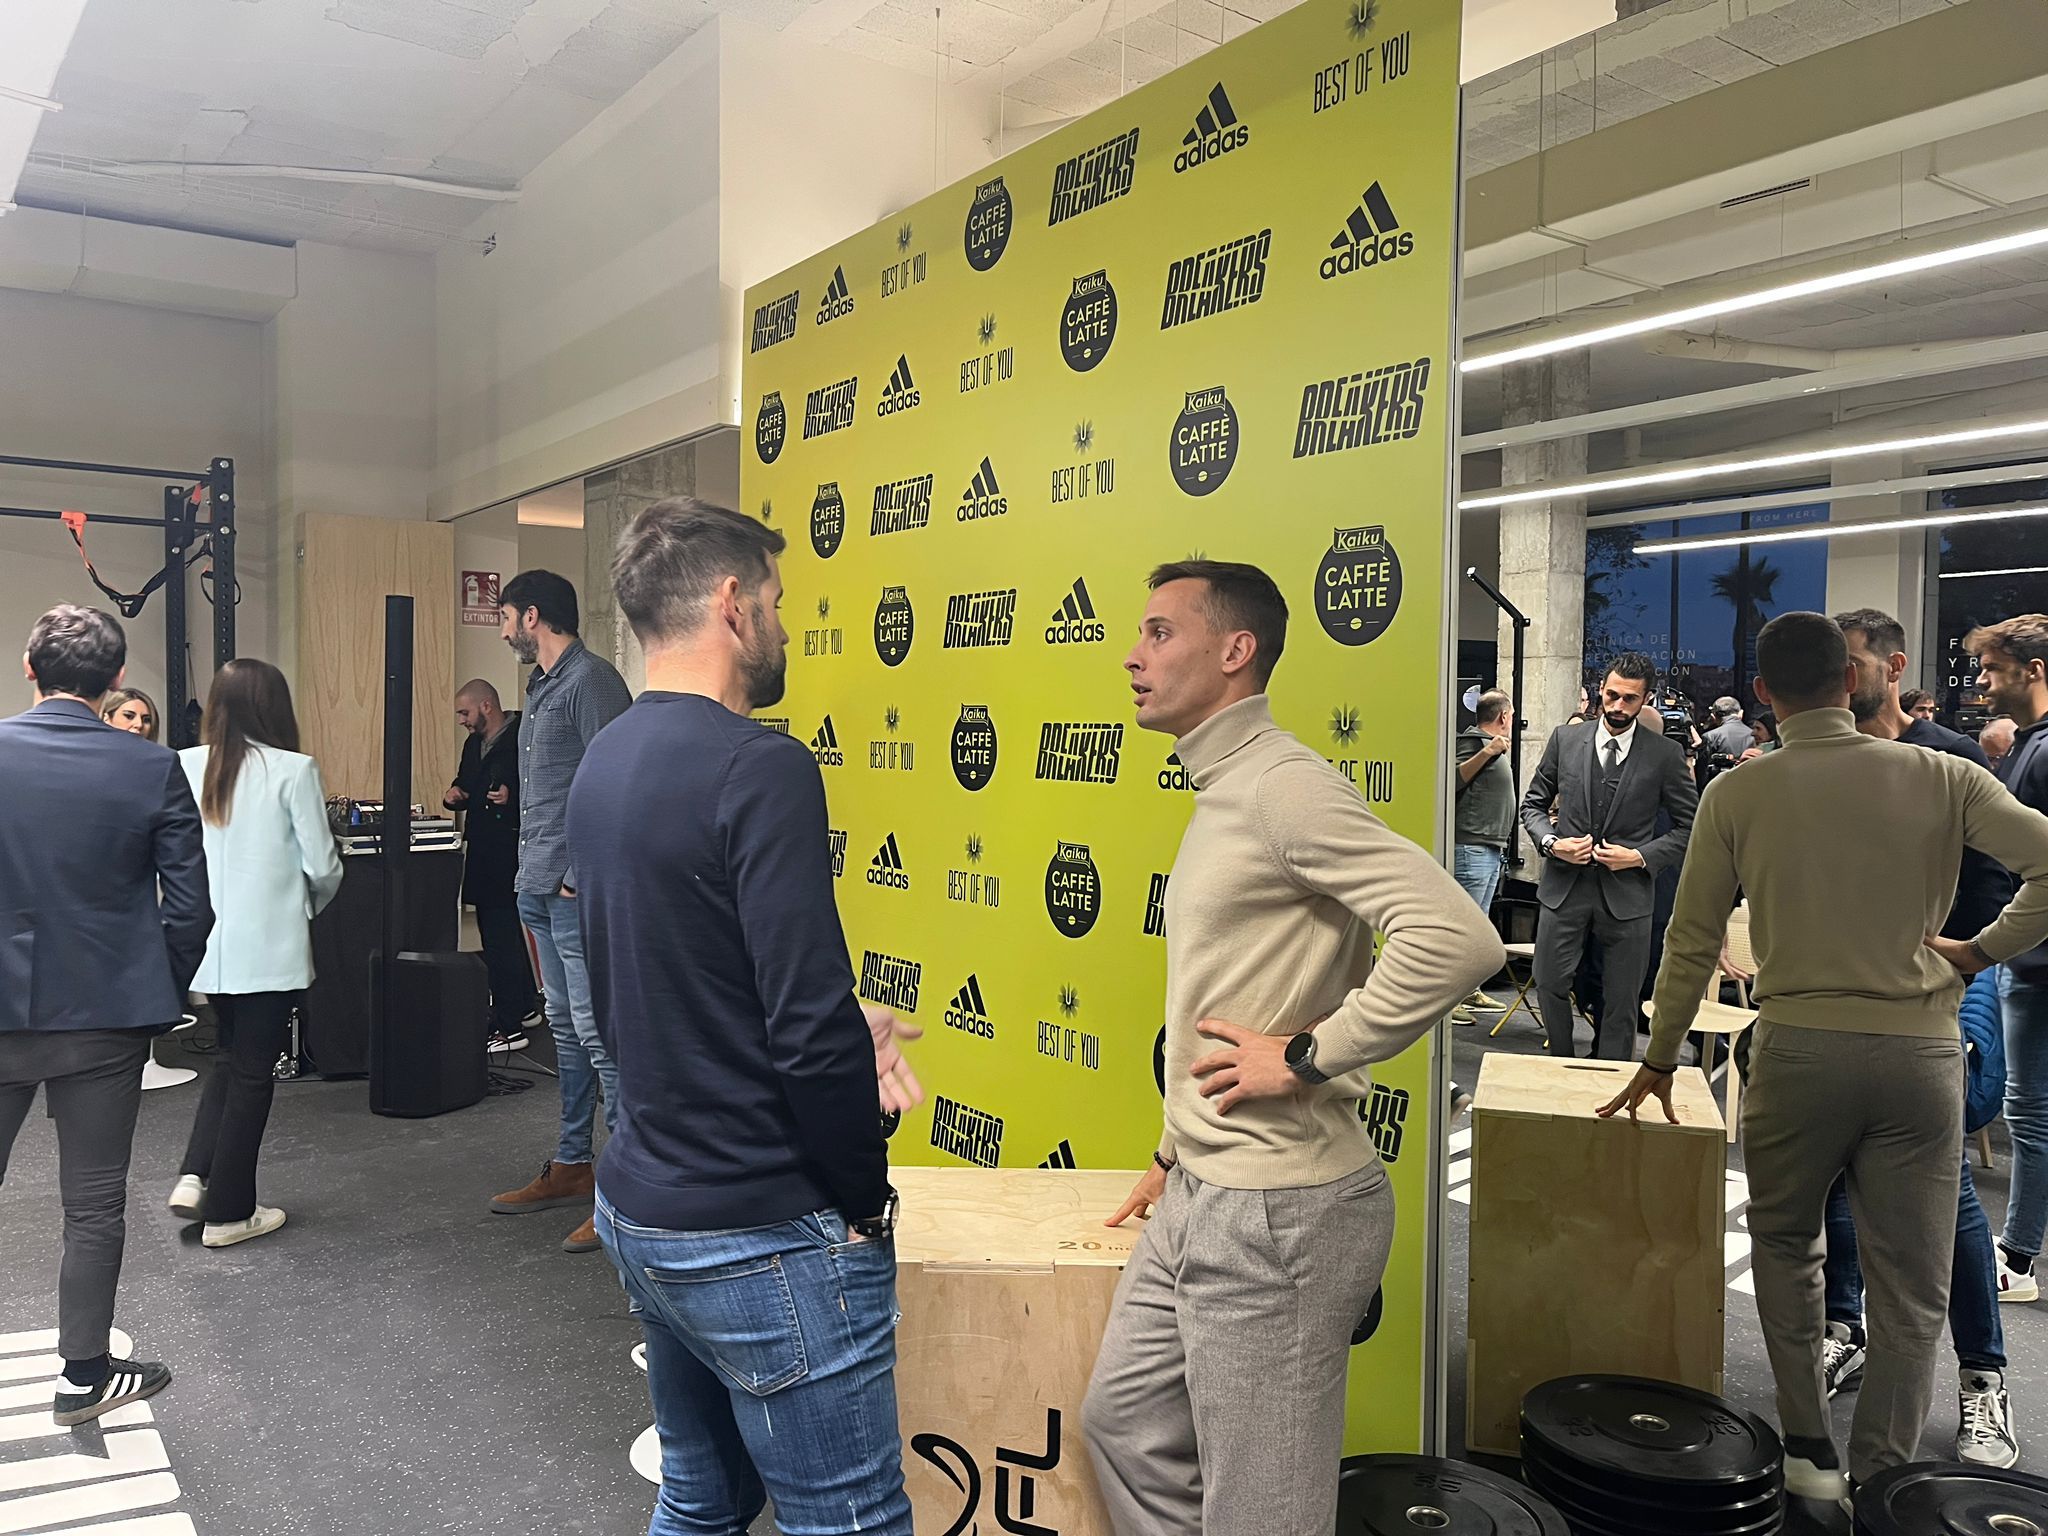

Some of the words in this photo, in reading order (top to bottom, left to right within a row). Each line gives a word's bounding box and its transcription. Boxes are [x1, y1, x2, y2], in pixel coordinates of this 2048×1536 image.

[1314, 58, 1349, 113] BEST
[1355, 47, 1374, 95] OF
[1381, 30, 1410, 84] YOU
[1174, 125, 1249, 173] adidas
[977, 182, 1002, 200] Kaiku
[970, 198, 1007, 231] CAFFÈ
[971, 225, 1004, 249] LATTE
[1320, 230, 1414, 281] adidas
[881, 263, 900, 298] BEST
[901, 260, 911, 289] OF
[912, 252, 927, 284] YOU
[1075, 275, 1104, 295] Kaiku
[816, 296, 854, 326] adidas
[1067, 293, 1110, 327] CAFFÈ
[1068, 319, 1108, 347] LATTE
[960, 359, 980, 393] BEST
[983, 355, 994, 386] OF
[997, 347, 1013, 379] YOU
[877, 389, 920, 417] adidas
[1188, 391, 1222, 413] Kaiku
[759, 409, 782, 430] CAFFÈ
[1178, 413, 1230, 446] CAFFÈ
[760, 427, 781, 444] LATTE
[1180, 442, 1227, 467] LATTE
[1052, 465, 1074, 503] BEST
[1079, 463, 1091, 498] OF
[1096, 458, 1114, 495] YOU
[814, 502, 840, 522] CAFFÈ
[957, 496, 1008, 522] adidas
[815, 520, 840, 537] LATTE
[1337, 530, 1381, 552] Kaiku
[1325, 557, 1390, 587] CAFFÈ
[1327, 587, 1388, 611] LATTE
[463, 612, 499, 623] EXTINTOR
[878, 606, 909, 626] CAFFÈ
[804, 631, 818, 656] BEST
[820, 630, 829, 655] OF
[831, 628, 842, 655] YOU
[879, 625, 908, 642] LATTE
[1045, 619, 1105, 645] adidas
[1650, 634, 1668, 645] DE
[1948, 657, 1957, 669] Y
[962, 706, 986, 721] Kaiku
[956, 728, 992, 748] CAFFÈ
[870, 741, 887, 769] BEST
[889, 742, 898, 769] OF
[900, 743, 914, 771] YOU
[957, 748, 990, 765] LATTE
[1365, 761, 1392, 802] YOU
[1059, 844, 1088, 862] Kaiku
[867, 868, 909, 890] adidas
[948, 870, 966, 902] BEST
[971, 873, 981, 904] OF
[984, 875, 1000, 908] YOU
[1051, 870, 1094, 892] CAFFÈ
[1053, 893, 1092, 912] LATTE
[944, 1008, 995, 1040] adidas
[1038, 1020, 1060, 1058] BEST
[1064, 1027, 1076, 1063] OF
[1080, 1033, 1100, 1070] YOU
[1057, 1241, 1102, 1251] 20
